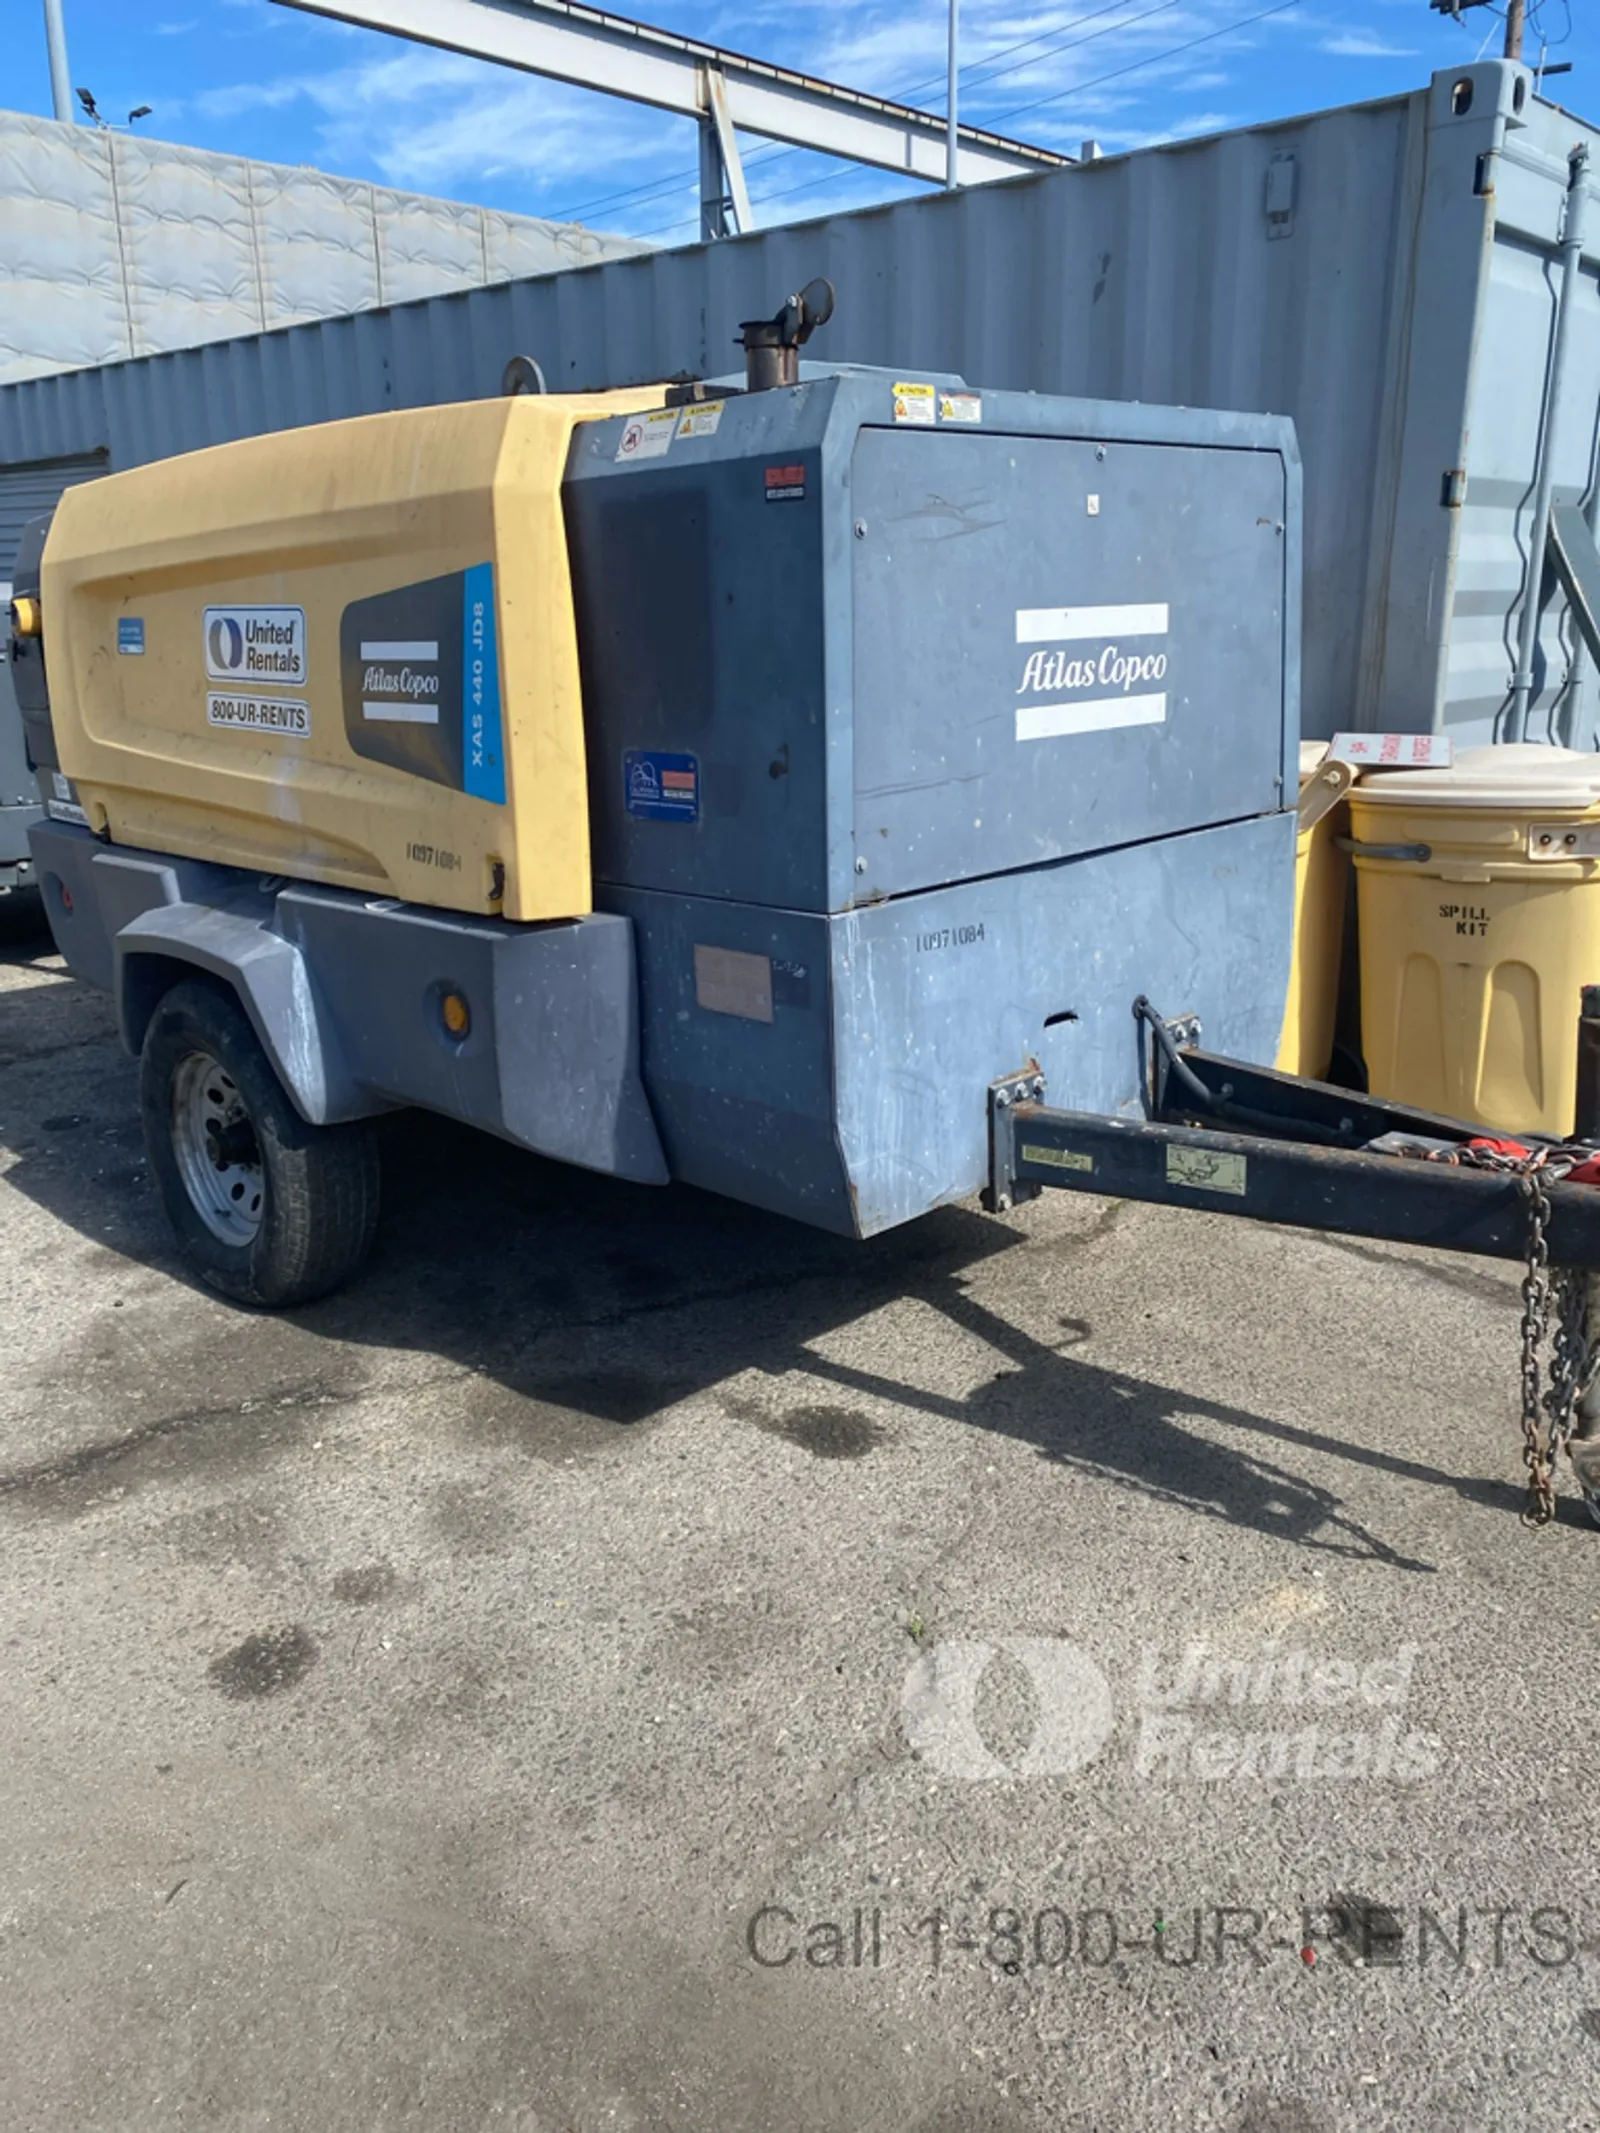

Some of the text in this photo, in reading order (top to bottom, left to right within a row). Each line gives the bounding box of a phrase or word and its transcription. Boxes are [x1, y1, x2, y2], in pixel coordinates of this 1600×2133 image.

[245, 619, 295, 645] United
[246, 646, 301, 674] Rentals
[1015, 645, 1167, 694] Atlas Copco
[362, 667, 439, 699] Atlas Copco
[471, 602, 484, 768] XAS 440 JD8
[212, 699, 306, 729] 800-UR-RENTS
[1439, 904, 1491, 921] SPILL
[916, 922, 985, 953] 10971084
[1456, 921, 1488, 937] KIT
